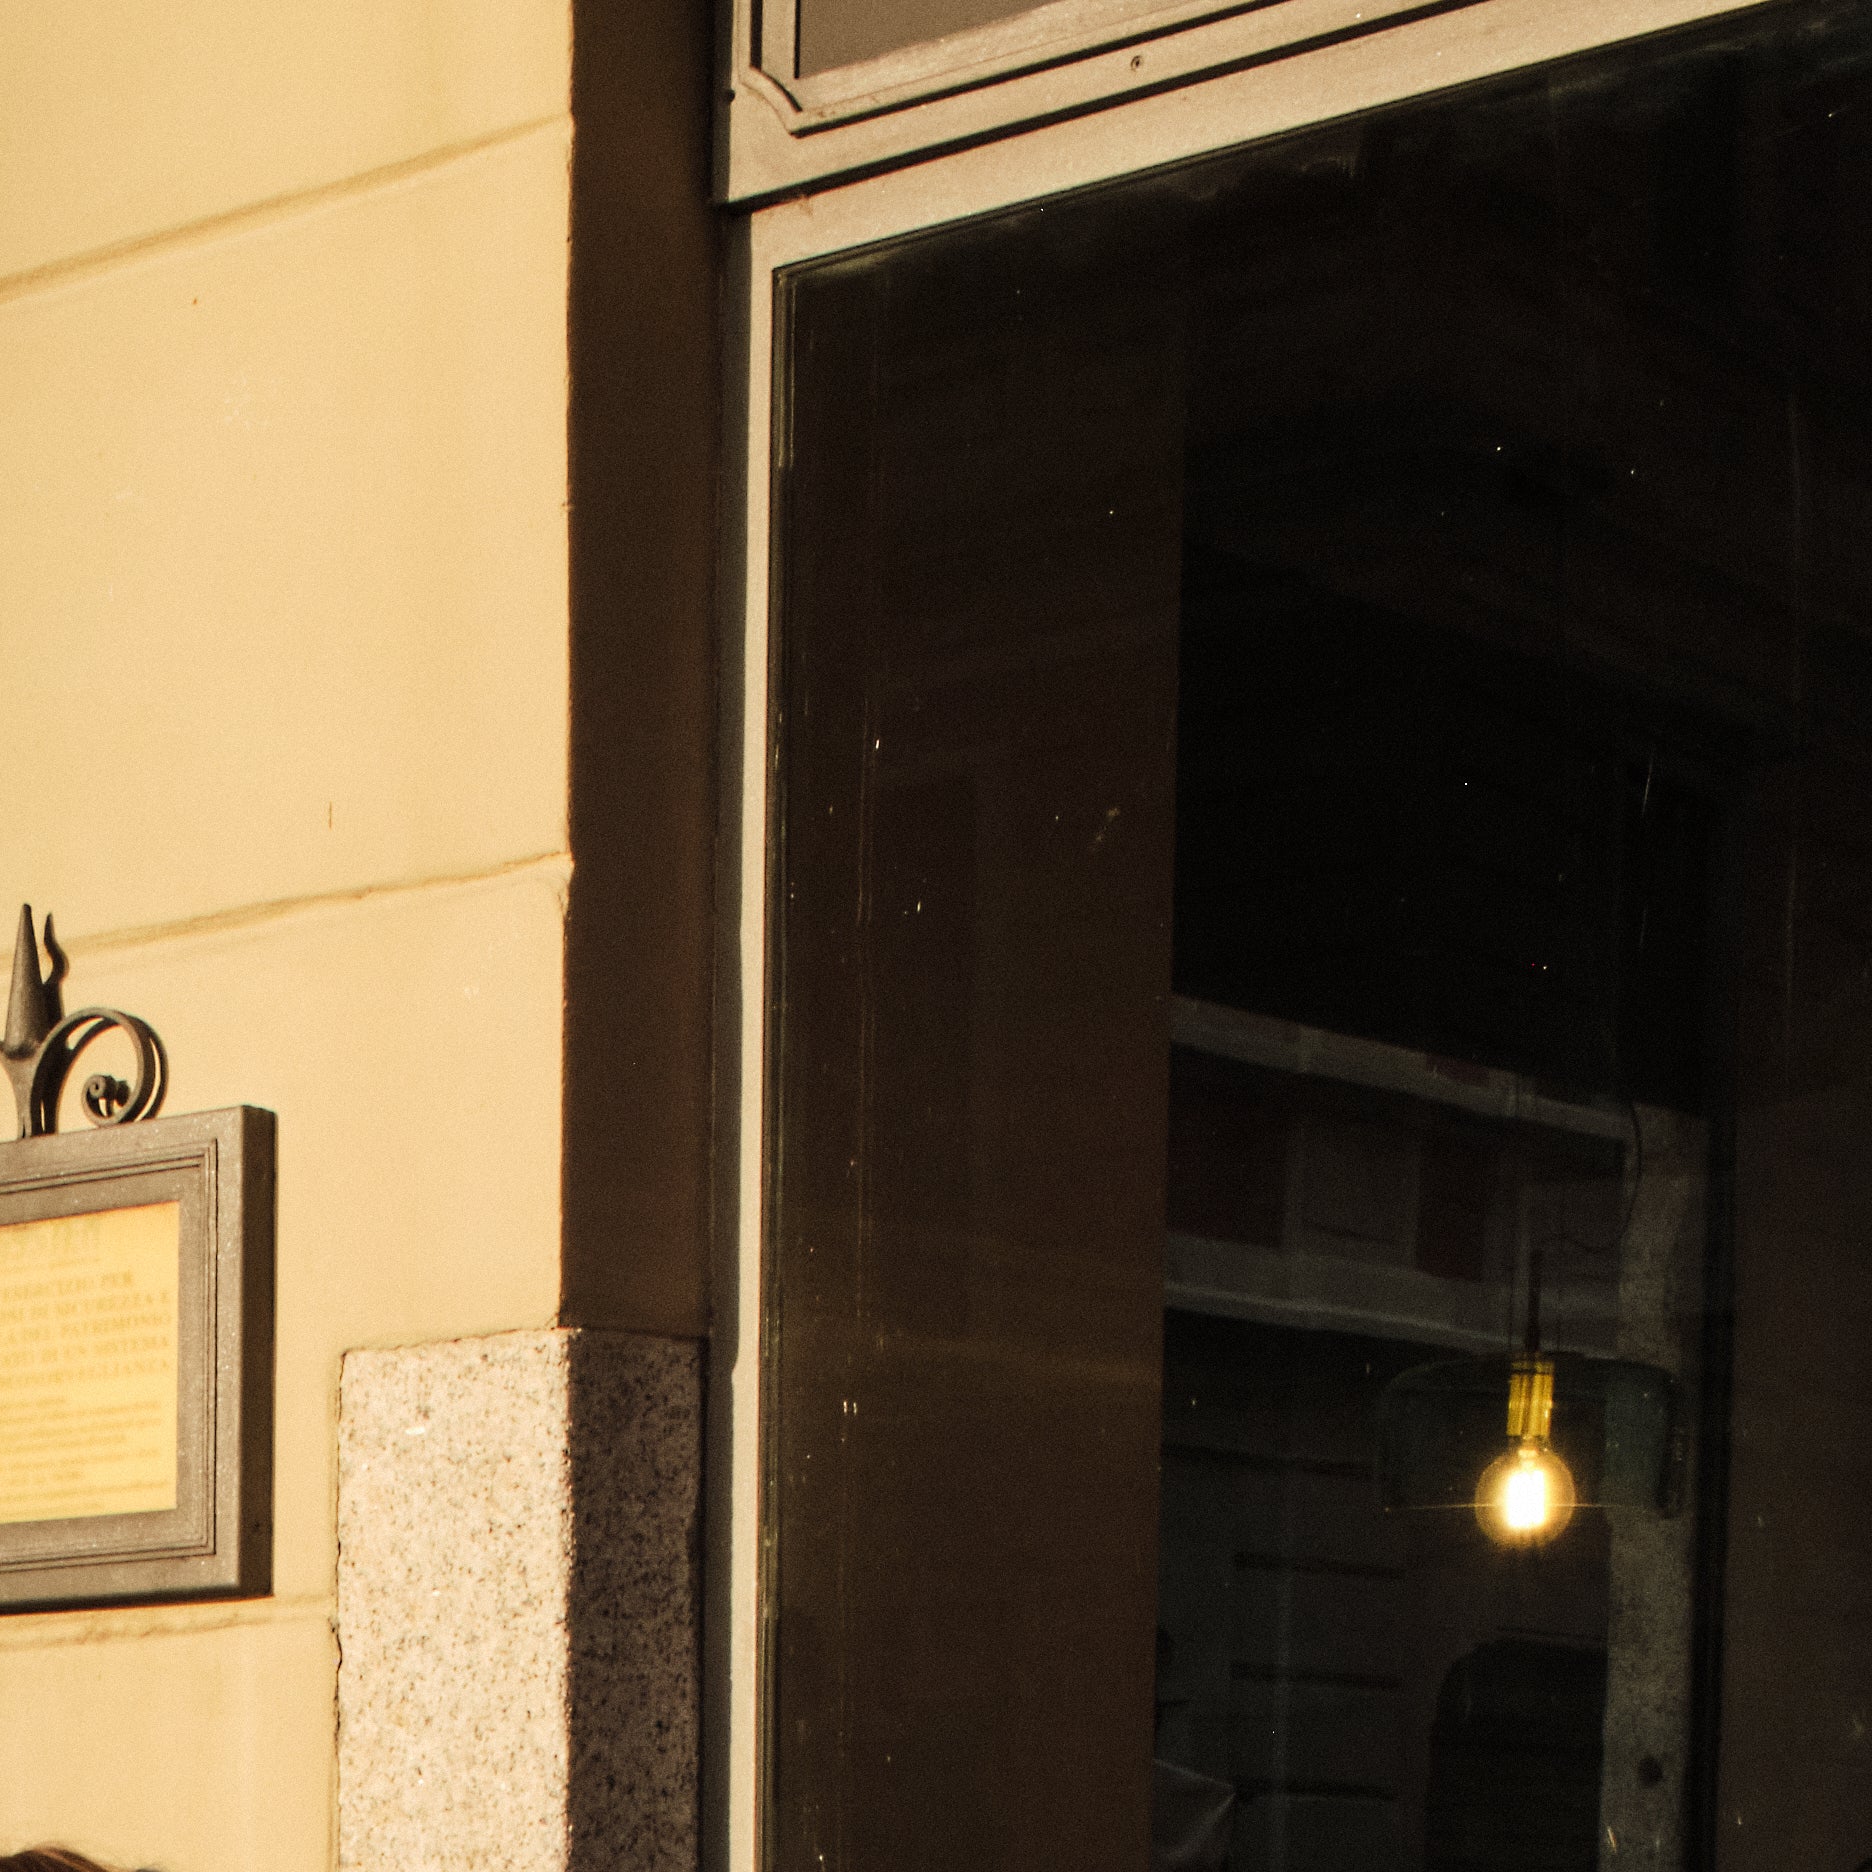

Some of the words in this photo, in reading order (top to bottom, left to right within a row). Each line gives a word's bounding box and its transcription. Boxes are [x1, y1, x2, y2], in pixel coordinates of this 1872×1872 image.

[55, 1292, 154, 1316] SICUREZZA
[60, 1311, 171, 1337] PATRIMONIO
[94, 1334, 170, 1355] SISTEMA
